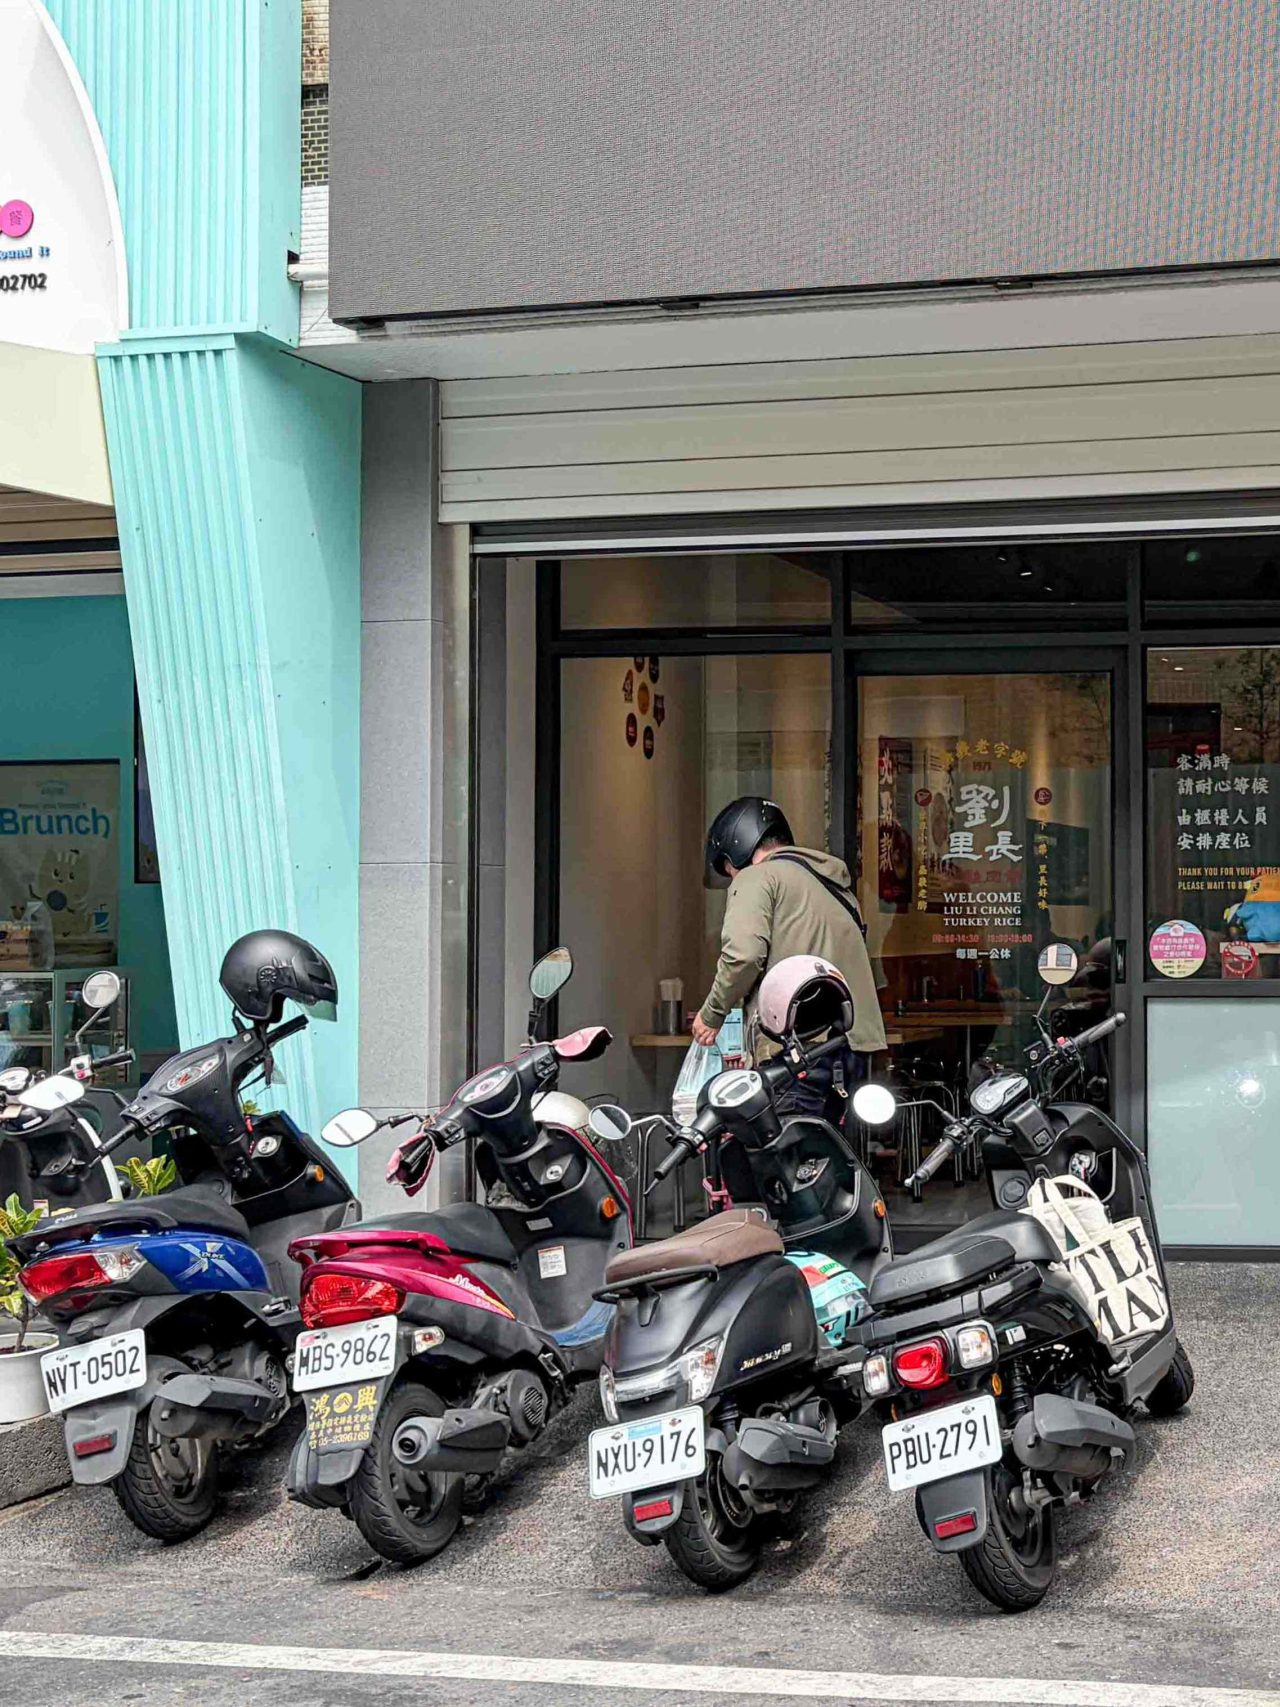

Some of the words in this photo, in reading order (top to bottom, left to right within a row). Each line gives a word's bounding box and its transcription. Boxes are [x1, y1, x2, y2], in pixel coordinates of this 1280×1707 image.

[0, 273, 47, 292] 02702
[1176, 753, 1231, 771] 客滿時
[1177, 776, 1269, 795] 請耐心等候
[955, 784, 1010, 829] 劉
[0, 807, 110, 839] Brunch
[942, 830, 1023, 862] 里長
[1177, 832, 1251, 850] 安排座位
[1178, 867, 1201, 876] THANK
[1204, 867, 1218, 876] YOU
[1220, 867, 1234, 876] FOR
[1236, 867, 1255, 876] YOUR
[1178, 881, 1204, 890] PLEASE
[1207, 881, 1224, 890] WAIT
[1227, 881, 1236, 890] TO
[943, 892, 1022, 903] WELCOME
[944, 906, 962, 915] LIU
[966, 906, 976, 915] LI
[981, 906, 1021, 915] CHANG
[943, 918, 990, 926] TURKEY
[994, 918, 1022, 926] RICE
[956, 948, 1011, 959] 每週一公休
